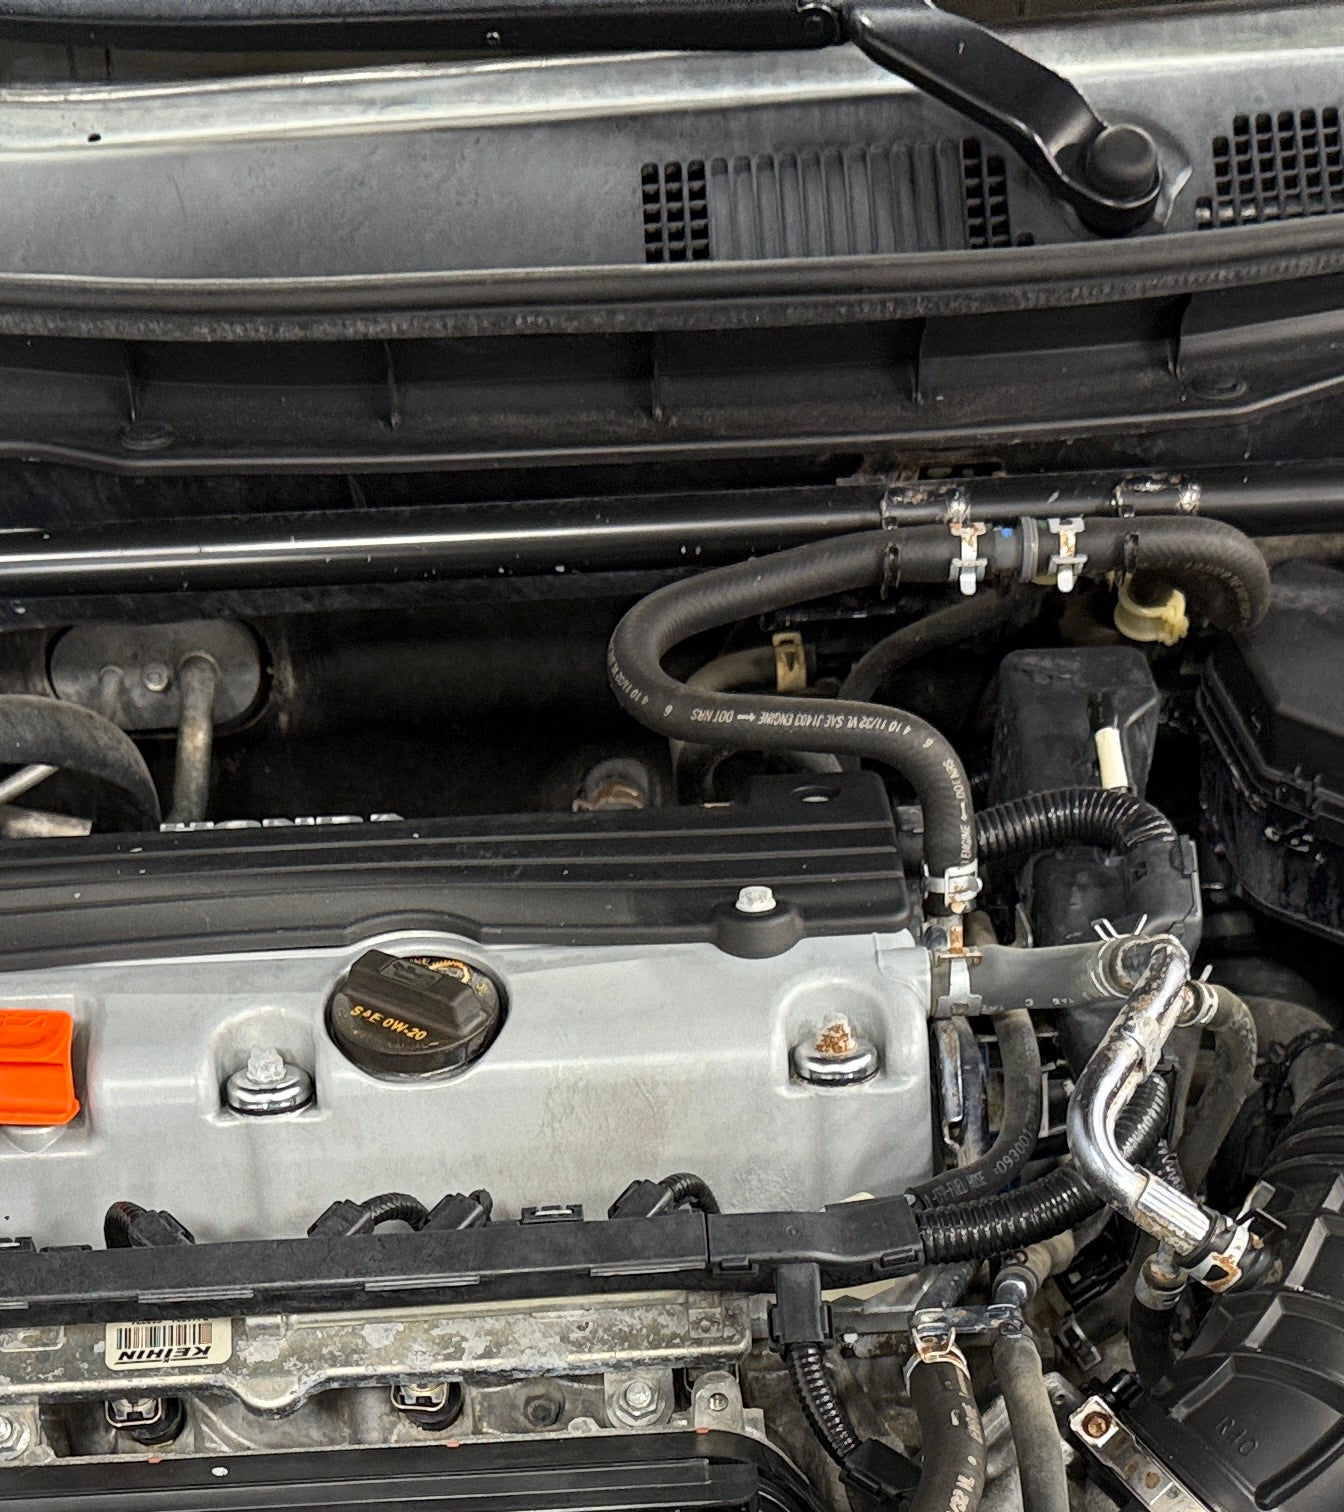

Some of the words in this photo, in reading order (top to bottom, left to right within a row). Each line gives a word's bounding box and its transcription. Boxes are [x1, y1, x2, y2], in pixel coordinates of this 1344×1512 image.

[757, 711, 793, 727] ENGINE
[824, 714, 845, 729] SAE
[350, 1005, 384, 1024] SAE
[382, 1017, 428, 1041] 0W-20
[117, 1346, 212, 1361] KEIHIN
